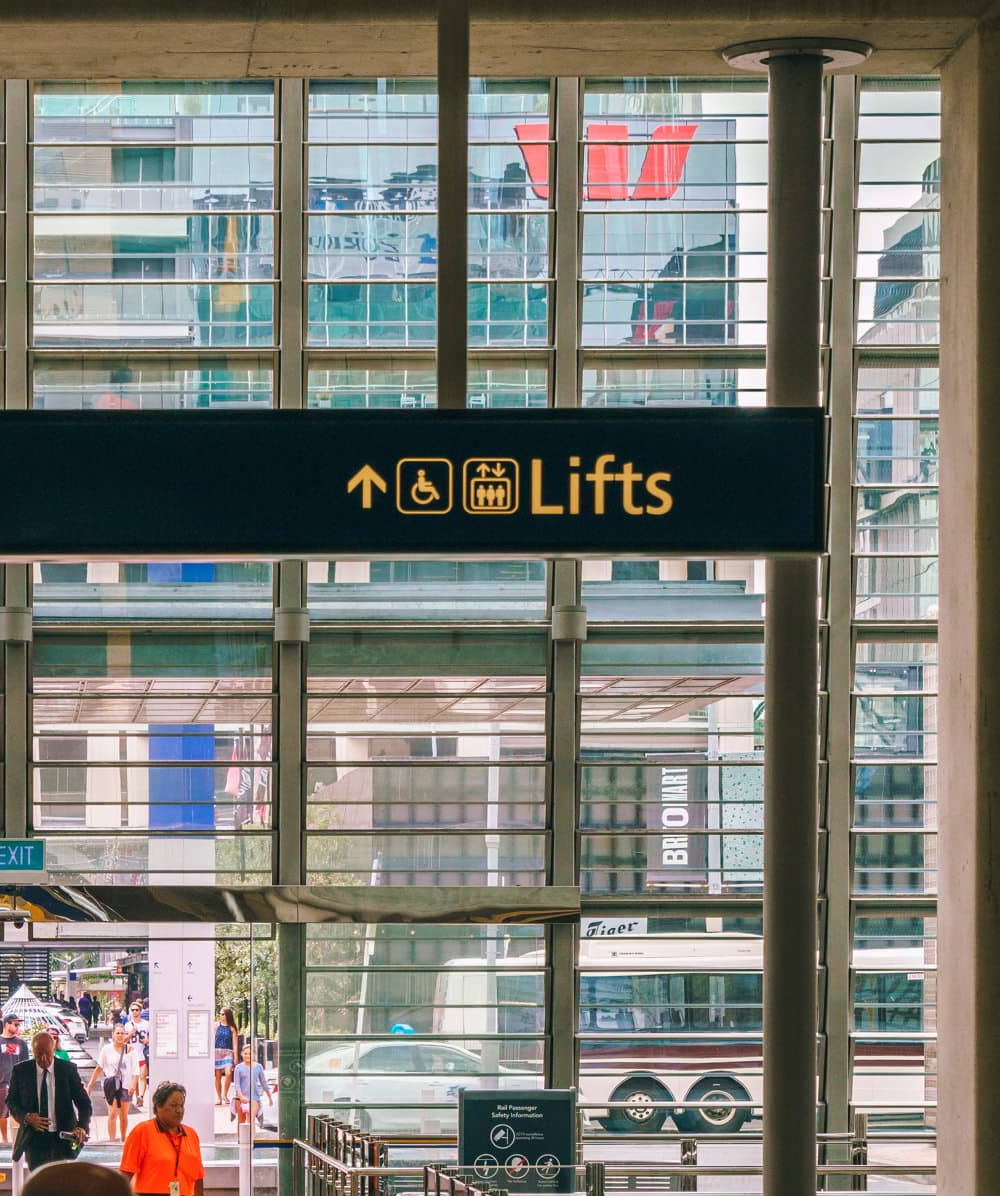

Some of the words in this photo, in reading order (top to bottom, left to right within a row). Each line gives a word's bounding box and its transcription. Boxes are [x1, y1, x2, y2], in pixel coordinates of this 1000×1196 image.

[530, 454, 674, 516] Lifts
[509, 1104, 538, 1113] Passenger
[491, 1112, 510, 1120] Safety
